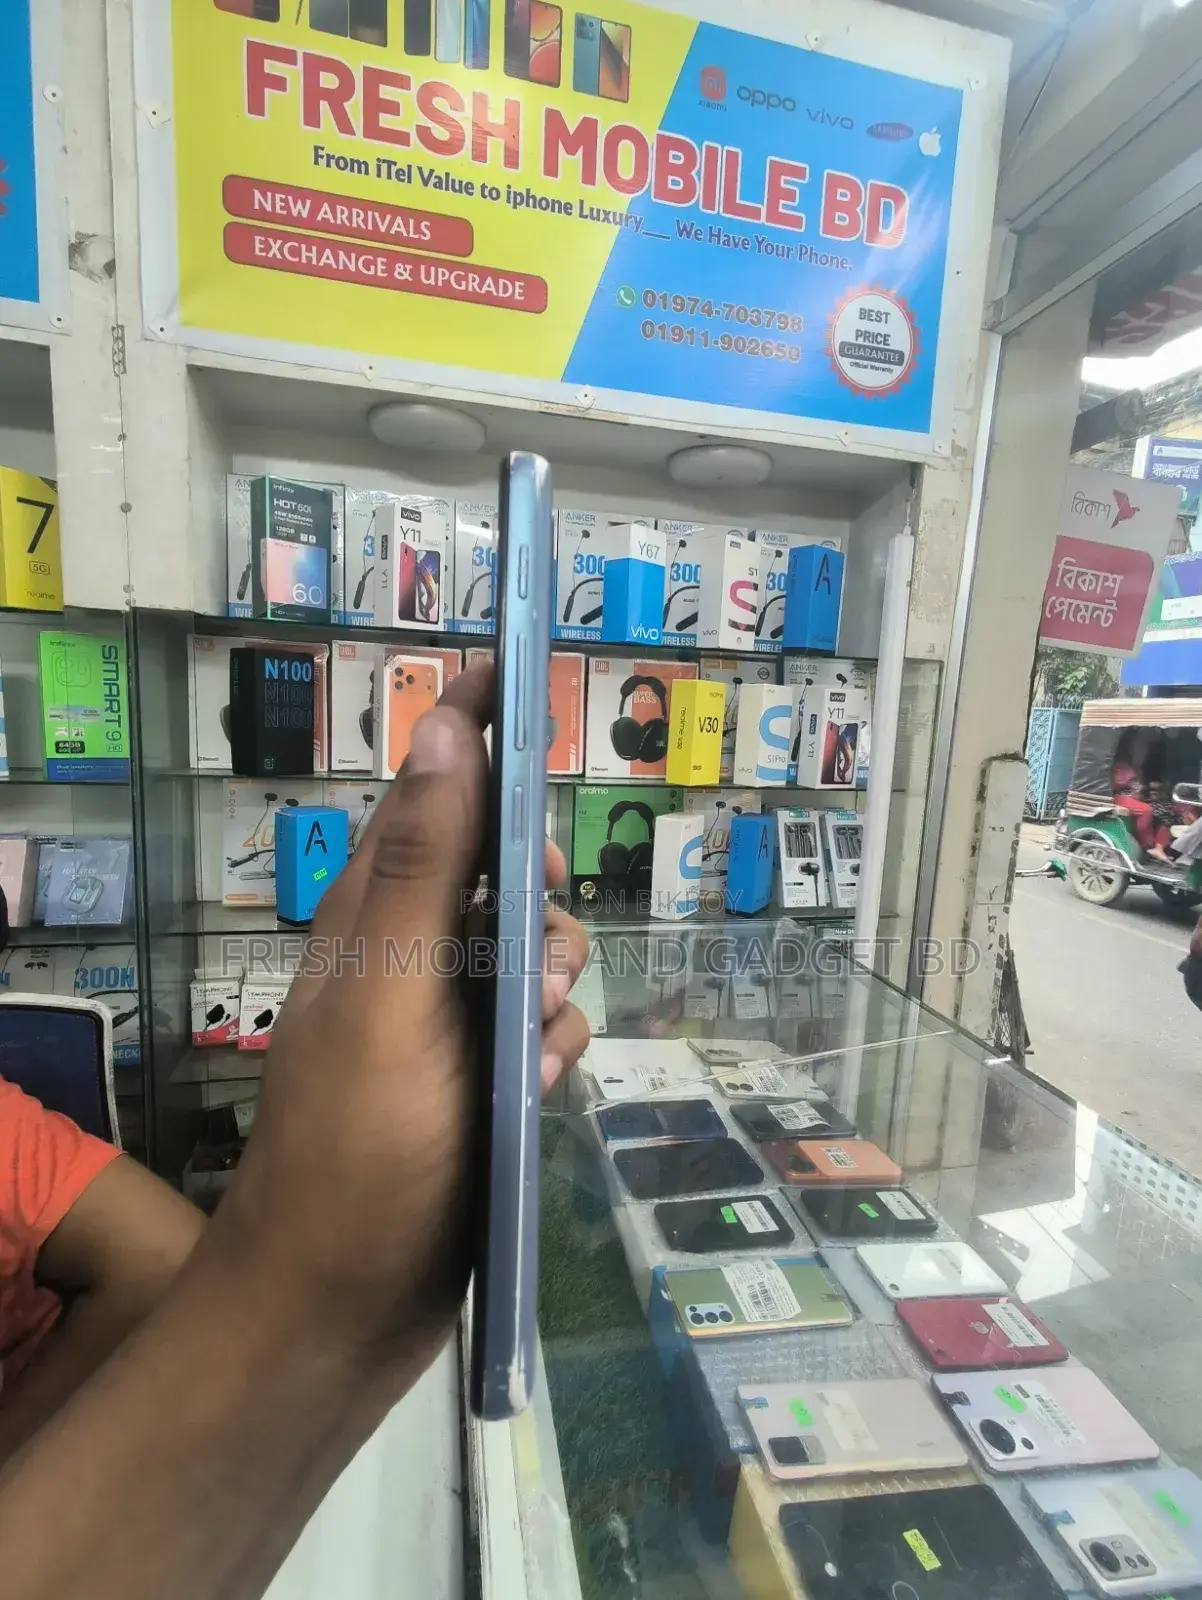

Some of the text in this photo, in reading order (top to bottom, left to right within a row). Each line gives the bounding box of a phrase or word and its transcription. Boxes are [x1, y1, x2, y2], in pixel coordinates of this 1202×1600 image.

[697, 100, 727, 112] xiaomi
[735, 85, 797, 112] oppo
[806, 108, 855, 131] vivo
[245, 38, 909, 248] FRESH MOBILE BD
[252, 188, 432, 242] NEW ARRIVALS
[312, 144, 370, 176] From
[375, 157, 413, 184] iTel
[416, 165, 476, 197] Value
[480, 182, 501, 202] to
[505, 185, 574, 216] iphone
[675, 218, 703, 241] We
[708, 226, 751, 251] Have
[754, 234, 794, 260] Your
[798, 243, 853, 271] Phone.
[253, 234, 526, 301] EXCHANGE & UPGRADE
[641, 288, 805, 334] 01974-703798
[858, 307, 892, 325] BEST
[640, 319, 802, 363] 01911-902650
[854, 328, 892, 347] PRICE
[843, 344, 901, 363] GUARANTEE
[849, 361, 870, 370] Official
[273, 498, 312, 514] HOT 60i
[461, 501, 496, 513] ANKER
[1070, 490, 1112, 520] বিকাশ
[1070, 490, 1112, 520] বিকাশ
[16, 495, 55, 554] 7
[402, 510, 421, 521] vivo
[565, 512, 596, 523] ANKER
[275, 525, 296, 535] 128GB
[400, 524, 422, 543] Y11
[663, 522, 692, 532] ANKER
[761, 533, 789, 543] ANKER
[637, 540, 661, 560] Y67
[32, 562, 48, 573] 5G
[1055, 556, 1124, 598] বিকাশ
[1055, 556, 1124, 598] বিকাশ
[26, 589, 56, 600] realme
[292, 582, 323, 606] 60
[1045, 594, 1118, 628] পেমেন্ট
[1045, 594, 1118, 628] পেমেন্ট
[560, 629, 601, 641] WIRELESS
[631, 622, 660, 641] vivo
[341, 645, 355, 657] JBL
[264, 657, 312, 683] N100
[788, 663, 818, 672] ANKER
[101, 644, 122, 742] SMART 9
[264, 681, 312, 706] N100
[633, 696, 657, 704] BASS
[831, 693, 846, 701] vivo
[264, 705, 313, 729] N100
[678, 706, 687, 735] realme
[827, 707, 845, 720] Y11
[698, 716, 719, 734] V30
[579, 786, 609, 795] oraimo
[303, 820, 328, 857] A
[74, 966, 135, 989] 300N
